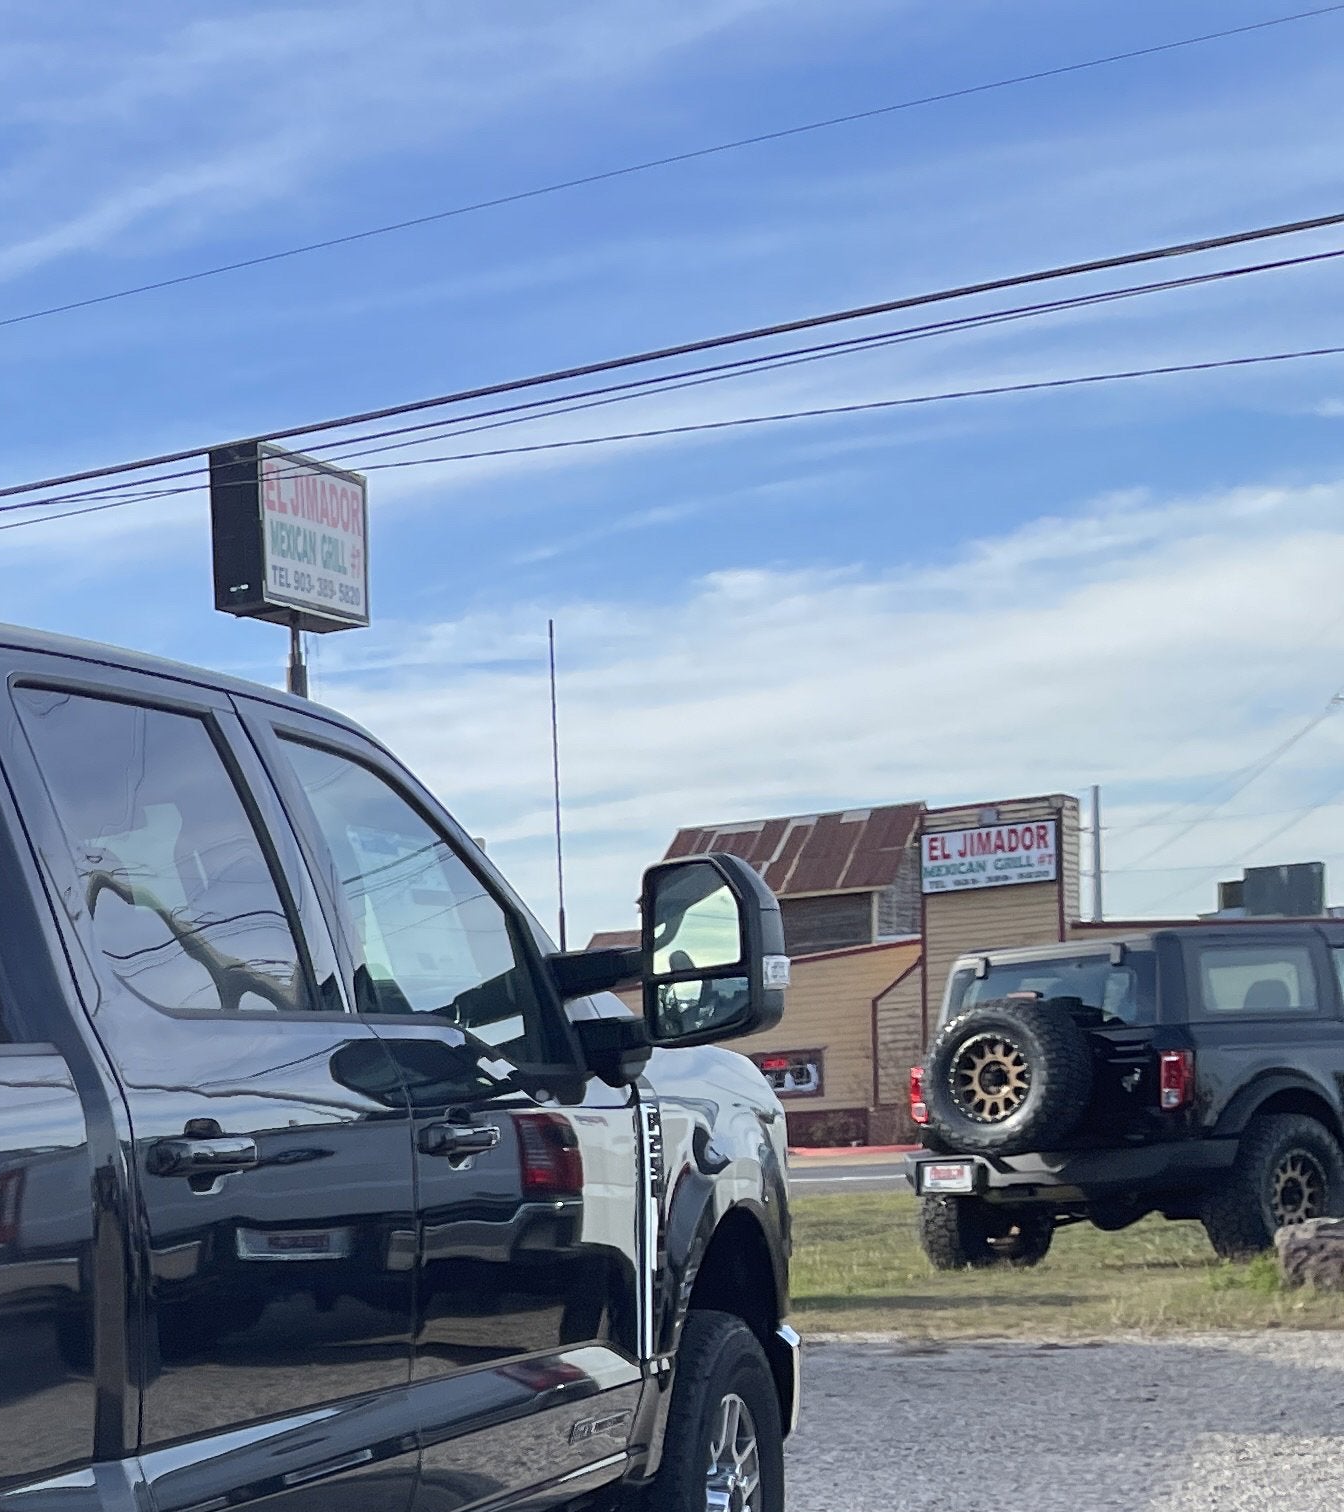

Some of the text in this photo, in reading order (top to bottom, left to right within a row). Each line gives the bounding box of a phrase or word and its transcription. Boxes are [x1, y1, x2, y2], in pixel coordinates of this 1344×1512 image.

[264, 463, 362, 537] EL JIMADOR
[270, 518, 316, 567] MEXICAN
[320, 532, 348, 576] GRILL
[928, 825, 1049, 861] EL JIMADOR
[923, 860, 986, 878] MEXICAN
[994, 856, 1036, 870] GRILL
